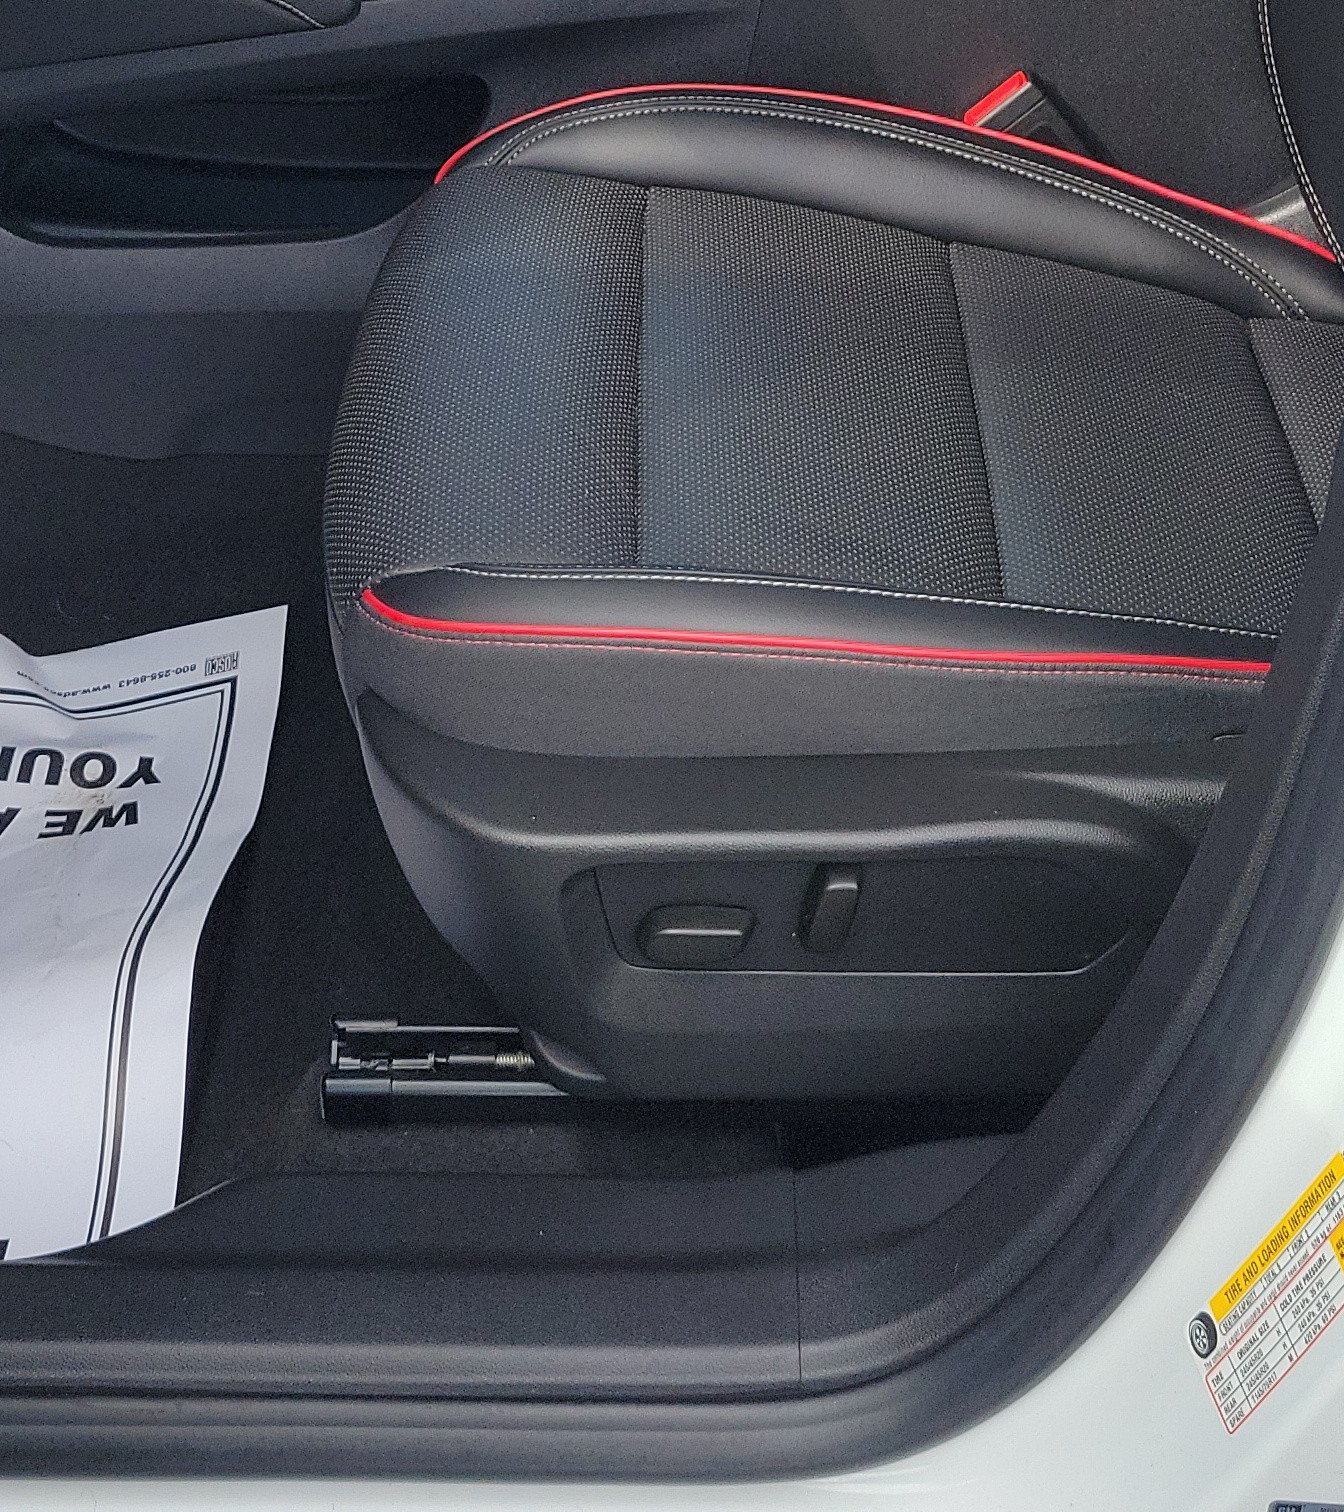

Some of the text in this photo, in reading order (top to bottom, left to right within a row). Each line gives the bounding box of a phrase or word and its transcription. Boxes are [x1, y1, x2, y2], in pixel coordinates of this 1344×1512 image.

[38, 798, 140, 840] WE
[1224, 1168, 1336, 1305] TIRE AND LOADING INFORMATION
[1279, 1252, 1327, 1312] COLD TIRE PRESSURE
[1211, 1371, 1223, 1388] TIRE
[1217, 1381, 1233, 1403] FRONT
[1229, 1406, 1244, 1430] SPARE
